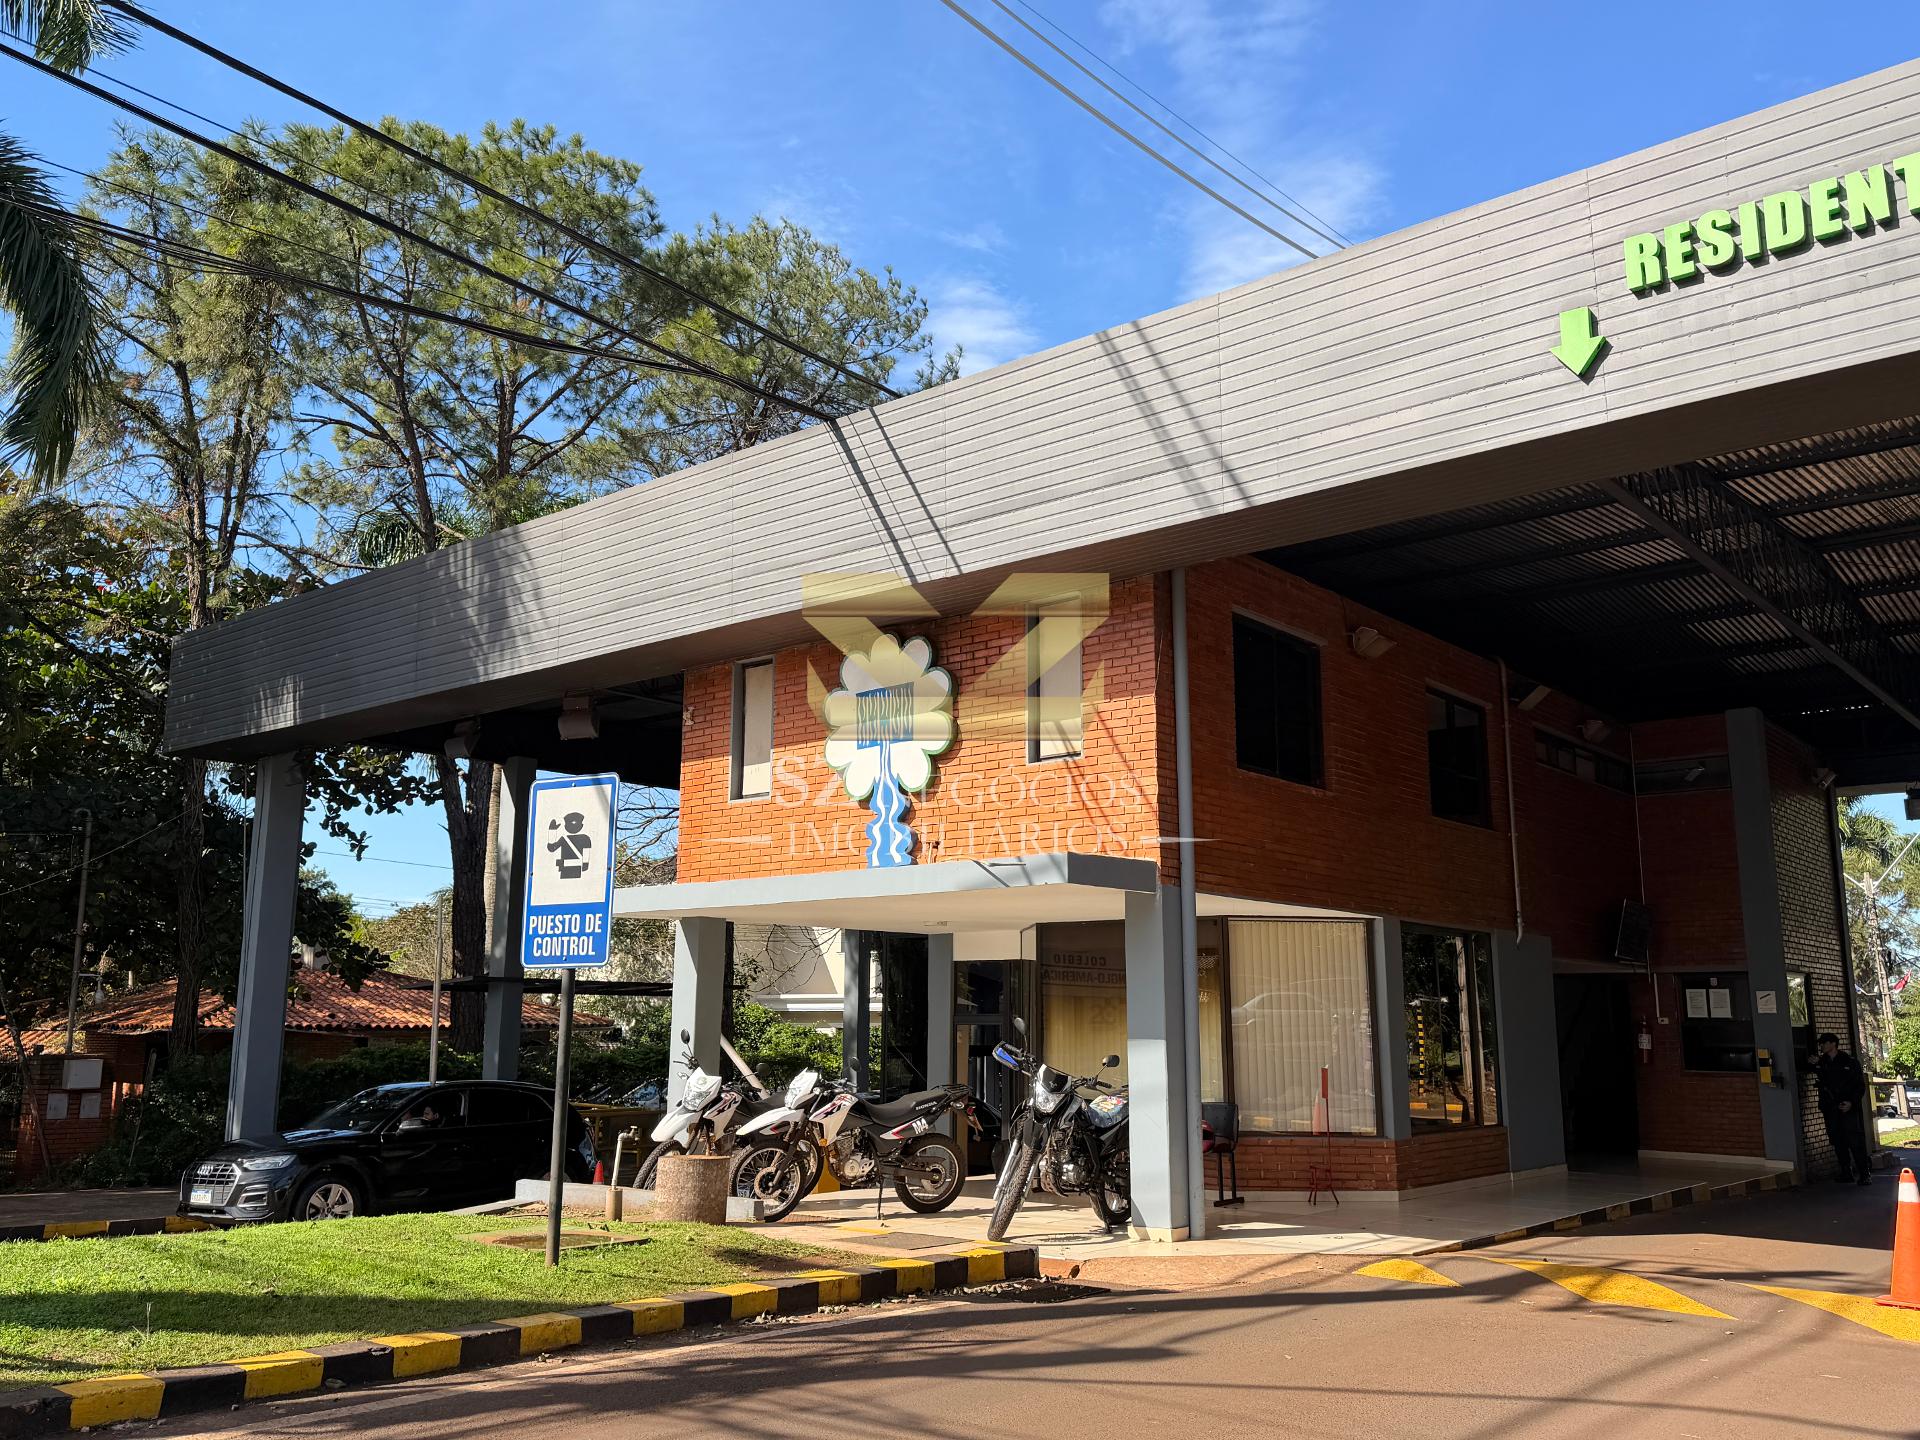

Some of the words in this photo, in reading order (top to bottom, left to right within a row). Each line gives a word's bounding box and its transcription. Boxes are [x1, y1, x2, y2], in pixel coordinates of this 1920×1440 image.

[1623, 151, 1920, 292] RESIDENT
[528, 913, 581, 935] PUESTO
[585, 913, 603, 933] DE
[532, 936, 596, 957] CONTROL
[912, 1118, 928, 1134] M4
